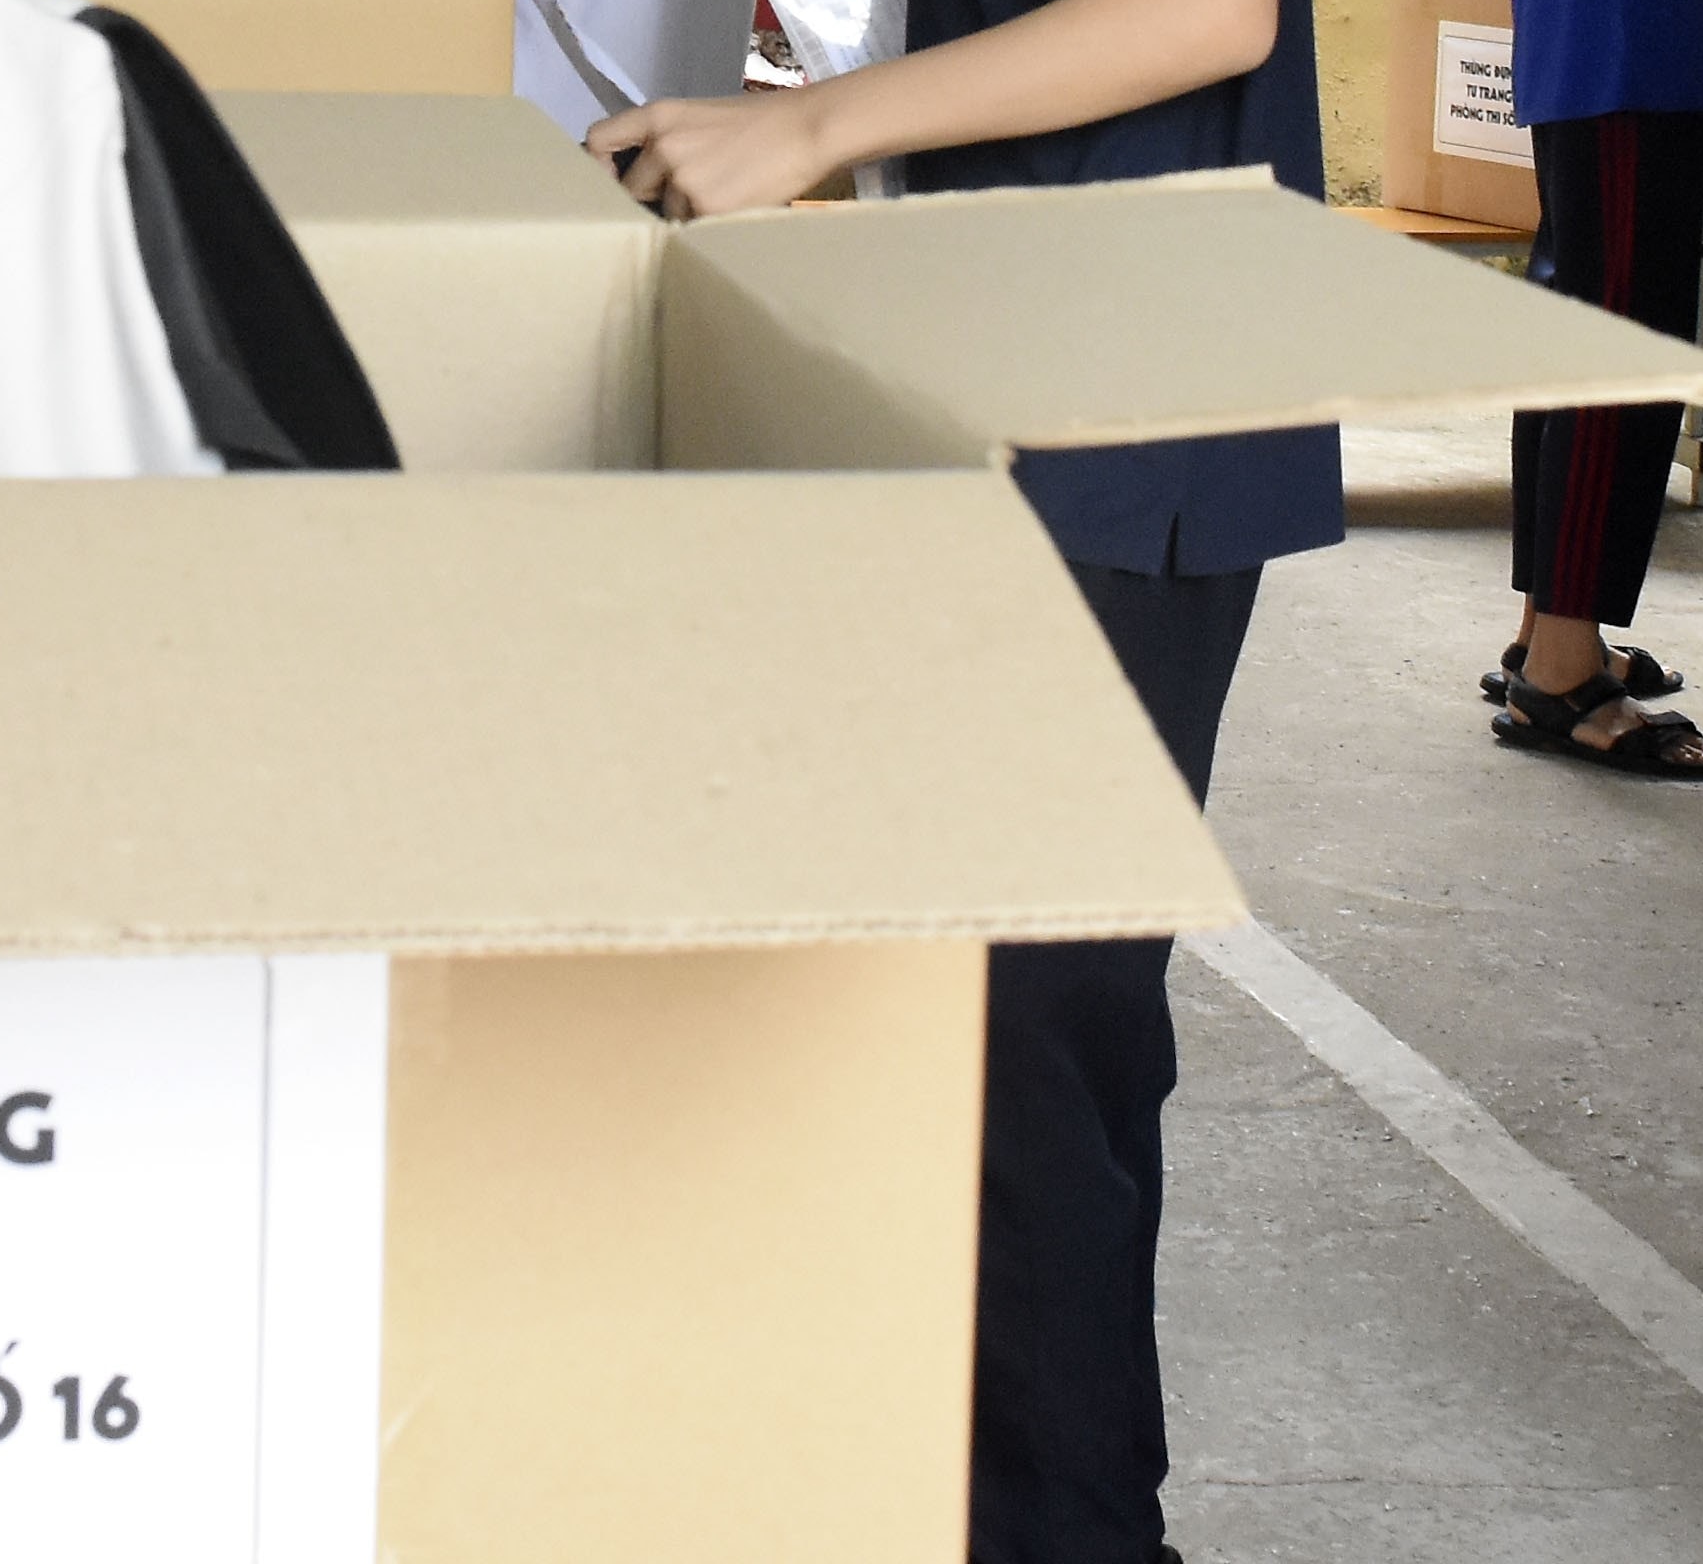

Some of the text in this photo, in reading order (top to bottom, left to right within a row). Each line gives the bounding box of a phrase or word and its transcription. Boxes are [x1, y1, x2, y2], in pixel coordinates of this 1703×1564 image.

[1479, 86, 1513, 103] TRANG
[1485, 109, 1501, 124] THI
[52, 1375, 140, 1441] 16
